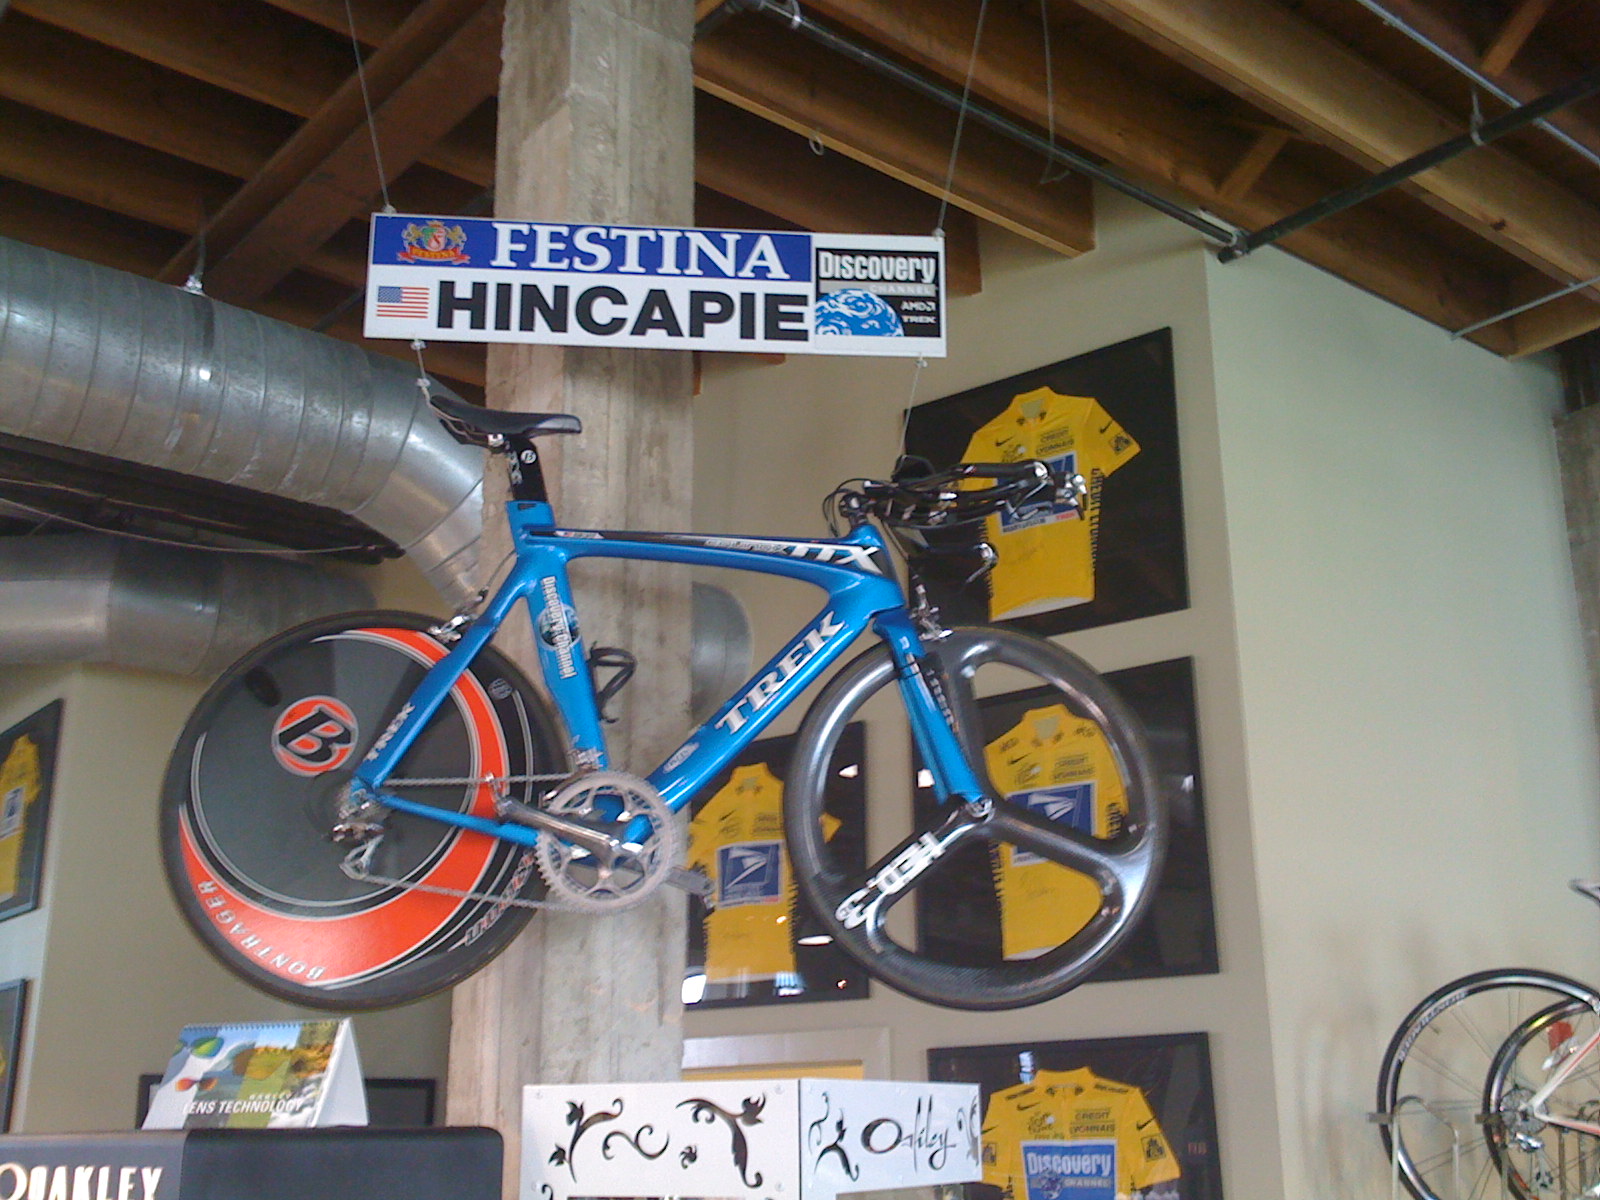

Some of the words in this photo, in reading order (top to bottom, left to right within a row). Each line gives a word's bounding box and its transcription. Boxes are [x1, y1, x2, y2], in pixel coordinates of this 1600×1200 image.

[491, 221, 791, 281] FESTINA
[436, 280, 809, 342] HINCAPIE
[868, 284, 932, 296] CHANNEL
[900, 300, 928, 312] AMD
[901, 315, 937, 324] TREK
[714, 610, 846, 735] TREK
[276, 704, 354, 766] B
[197, 878, 324, 981] BONTRAGER
[182, 1101, 216, 1115] LENS
[218, 1099, 304, 1114] TECHNOLOGY
